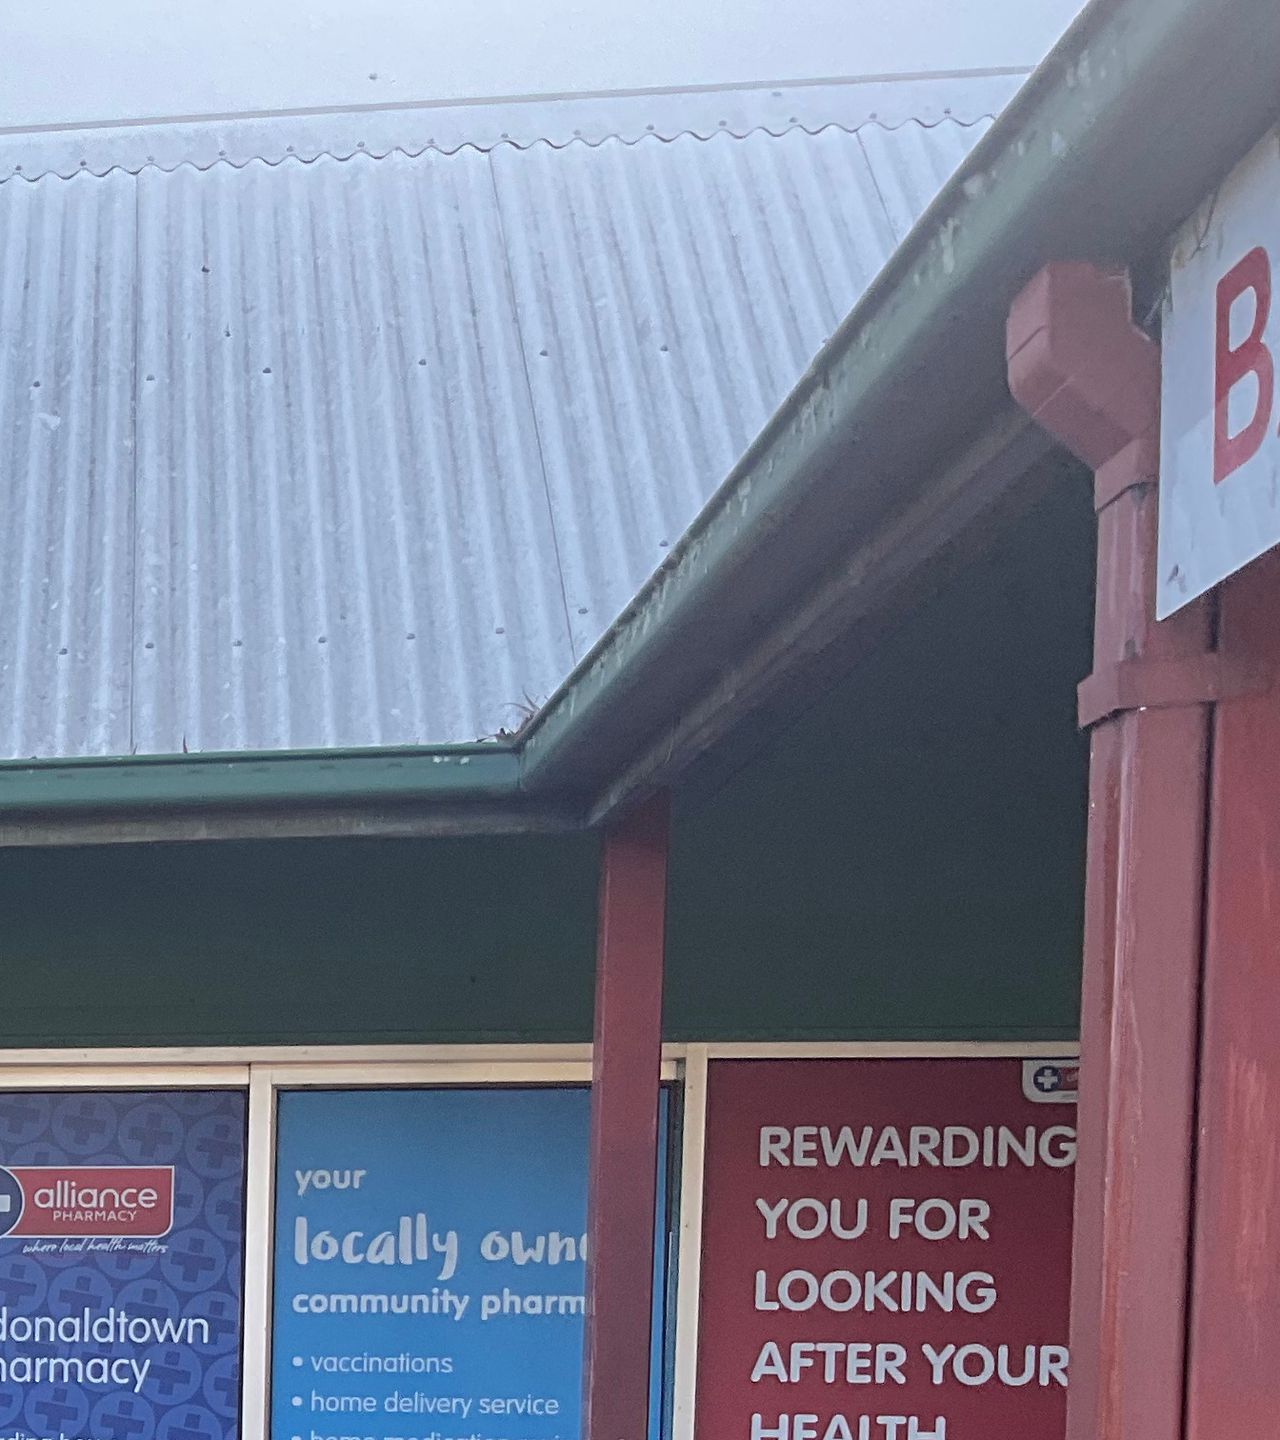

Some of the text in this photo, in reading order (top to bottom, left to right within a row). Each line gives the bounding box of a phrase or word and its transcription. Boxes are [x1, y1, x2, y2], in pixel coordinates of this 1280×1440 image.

[759, 1125, 1078, 1168] REWARDING
[33, 1180, 158, 1209] alliance
[295, 1168, 367, 1197] your
[52, 1210, 138, 1223] PHARMACY
[756, 1198, 991, 1241] YOU FOR
[58, 1238, 88, 1253] local
[87, 1237, 126, 1252] health
[127, 1239, 170, 1254] matters
[294, 1212, 459, 1281] locally
[292, 1287, 470, 1321] community
[754, 1269, 998, 1314] LOOKING
[310, 1352, 454, 1374] vaccinations
[750, 1341, 1070, 1387] AFTER YOUR
[311, 1391, 560, 1419] home delivery service
